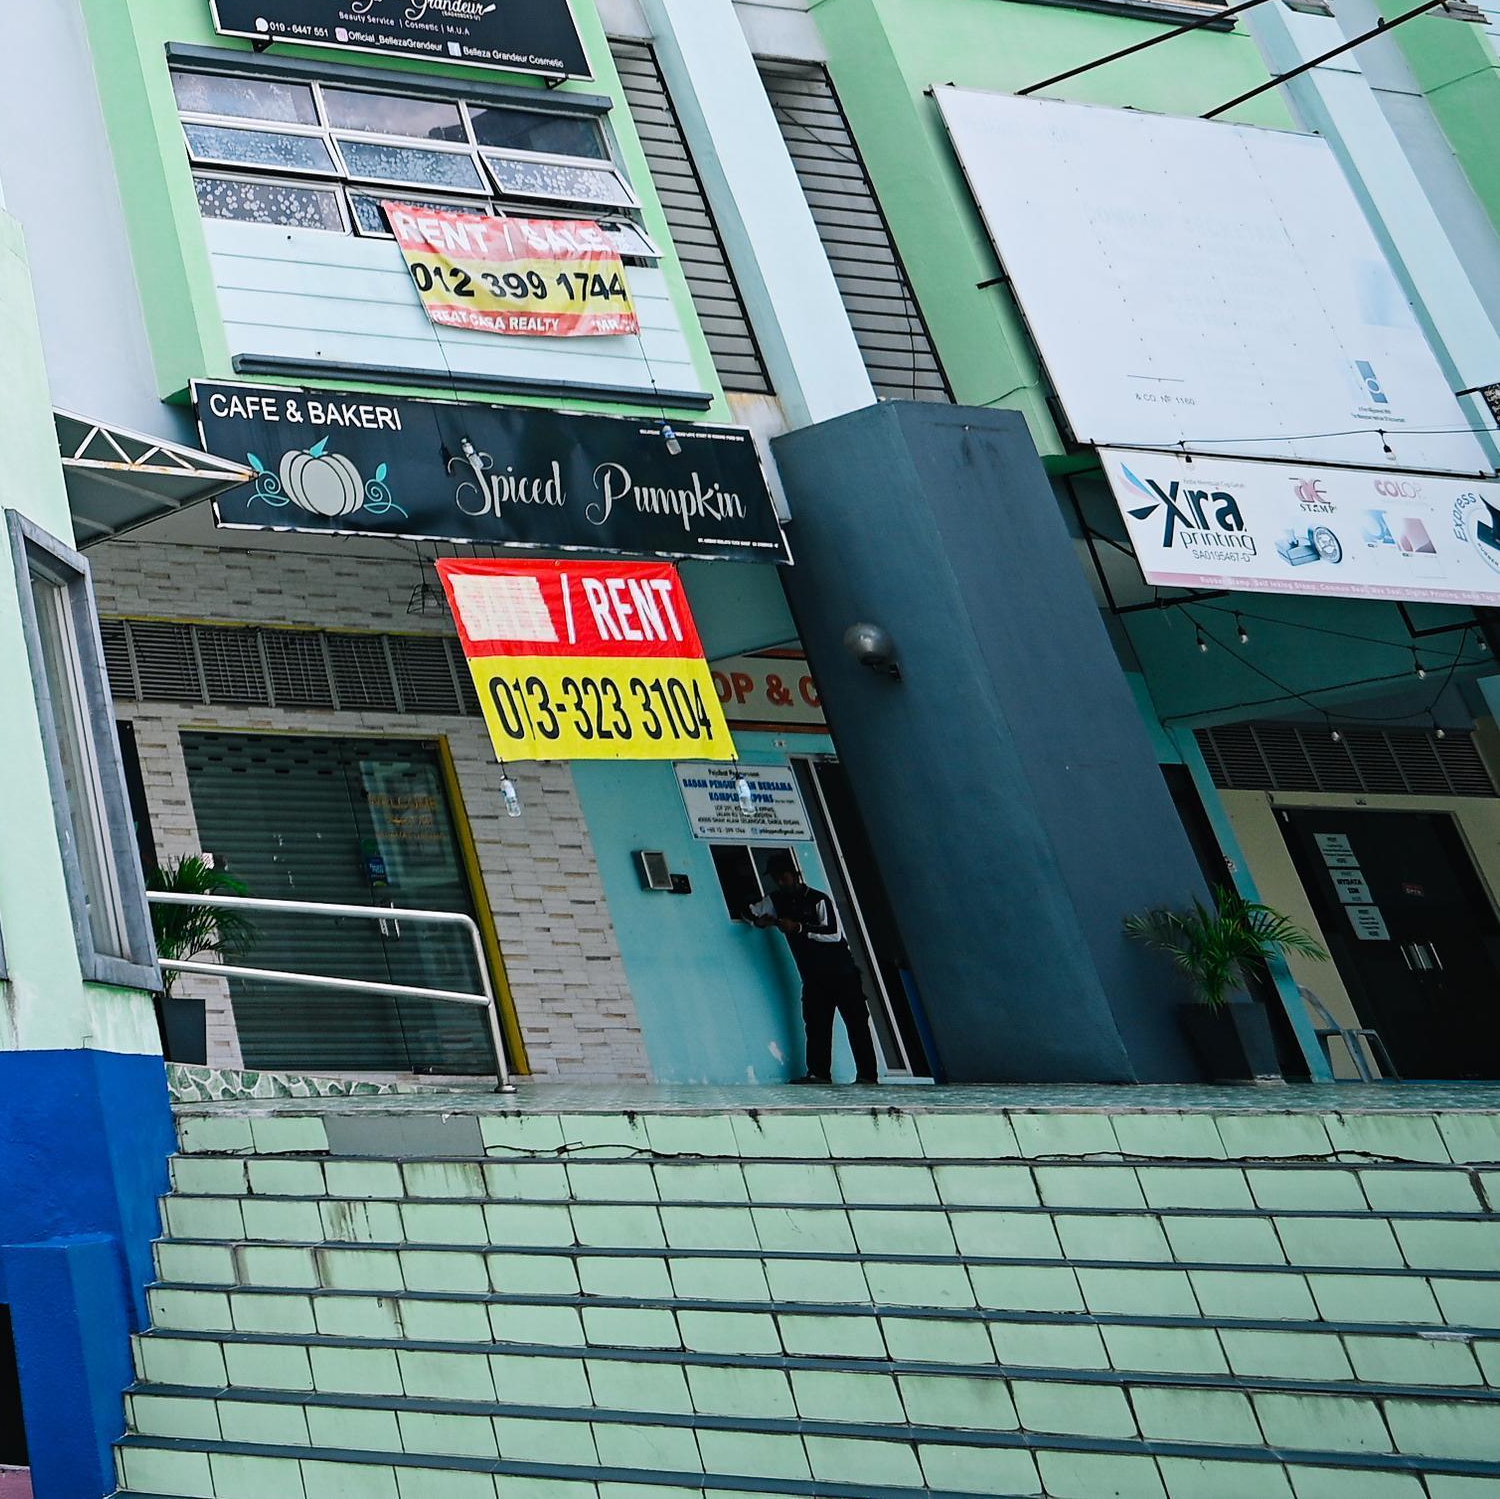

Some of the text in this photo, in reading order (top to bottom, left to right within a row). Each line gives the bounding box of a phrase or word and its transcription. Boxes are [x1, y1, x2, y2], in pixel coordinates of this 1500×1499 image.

[269, 21, 286, 32] 019
[462, 45, 491, 59] Belleza
[492, 49, 528, 63] Grandeur
[338, 10, 366, 24] Beauty
[366, 13, 396, 27] Service
[404, 19, 440, 33] Cosmetic
[393, 210, 490, 253] RENT
[520, 222, 614, 253] SALE
[410, 262, 627, 302] 012 399 1744
[467, 313, 506, 331] CASA
[508, 317, 561, 333] REALTY
[209, 393, 403, 431] CAFE & BAKERI
[448, 451, 747, 532] Spiced Pumpkin
[1452, 492, 1477, 543] Express
[1179, 530, 1258, 556] printing
[581, 577, 684, 643] RENT
[488, 676, 714, 742] 013-323 3104
[766, 674, 794, 708] &
